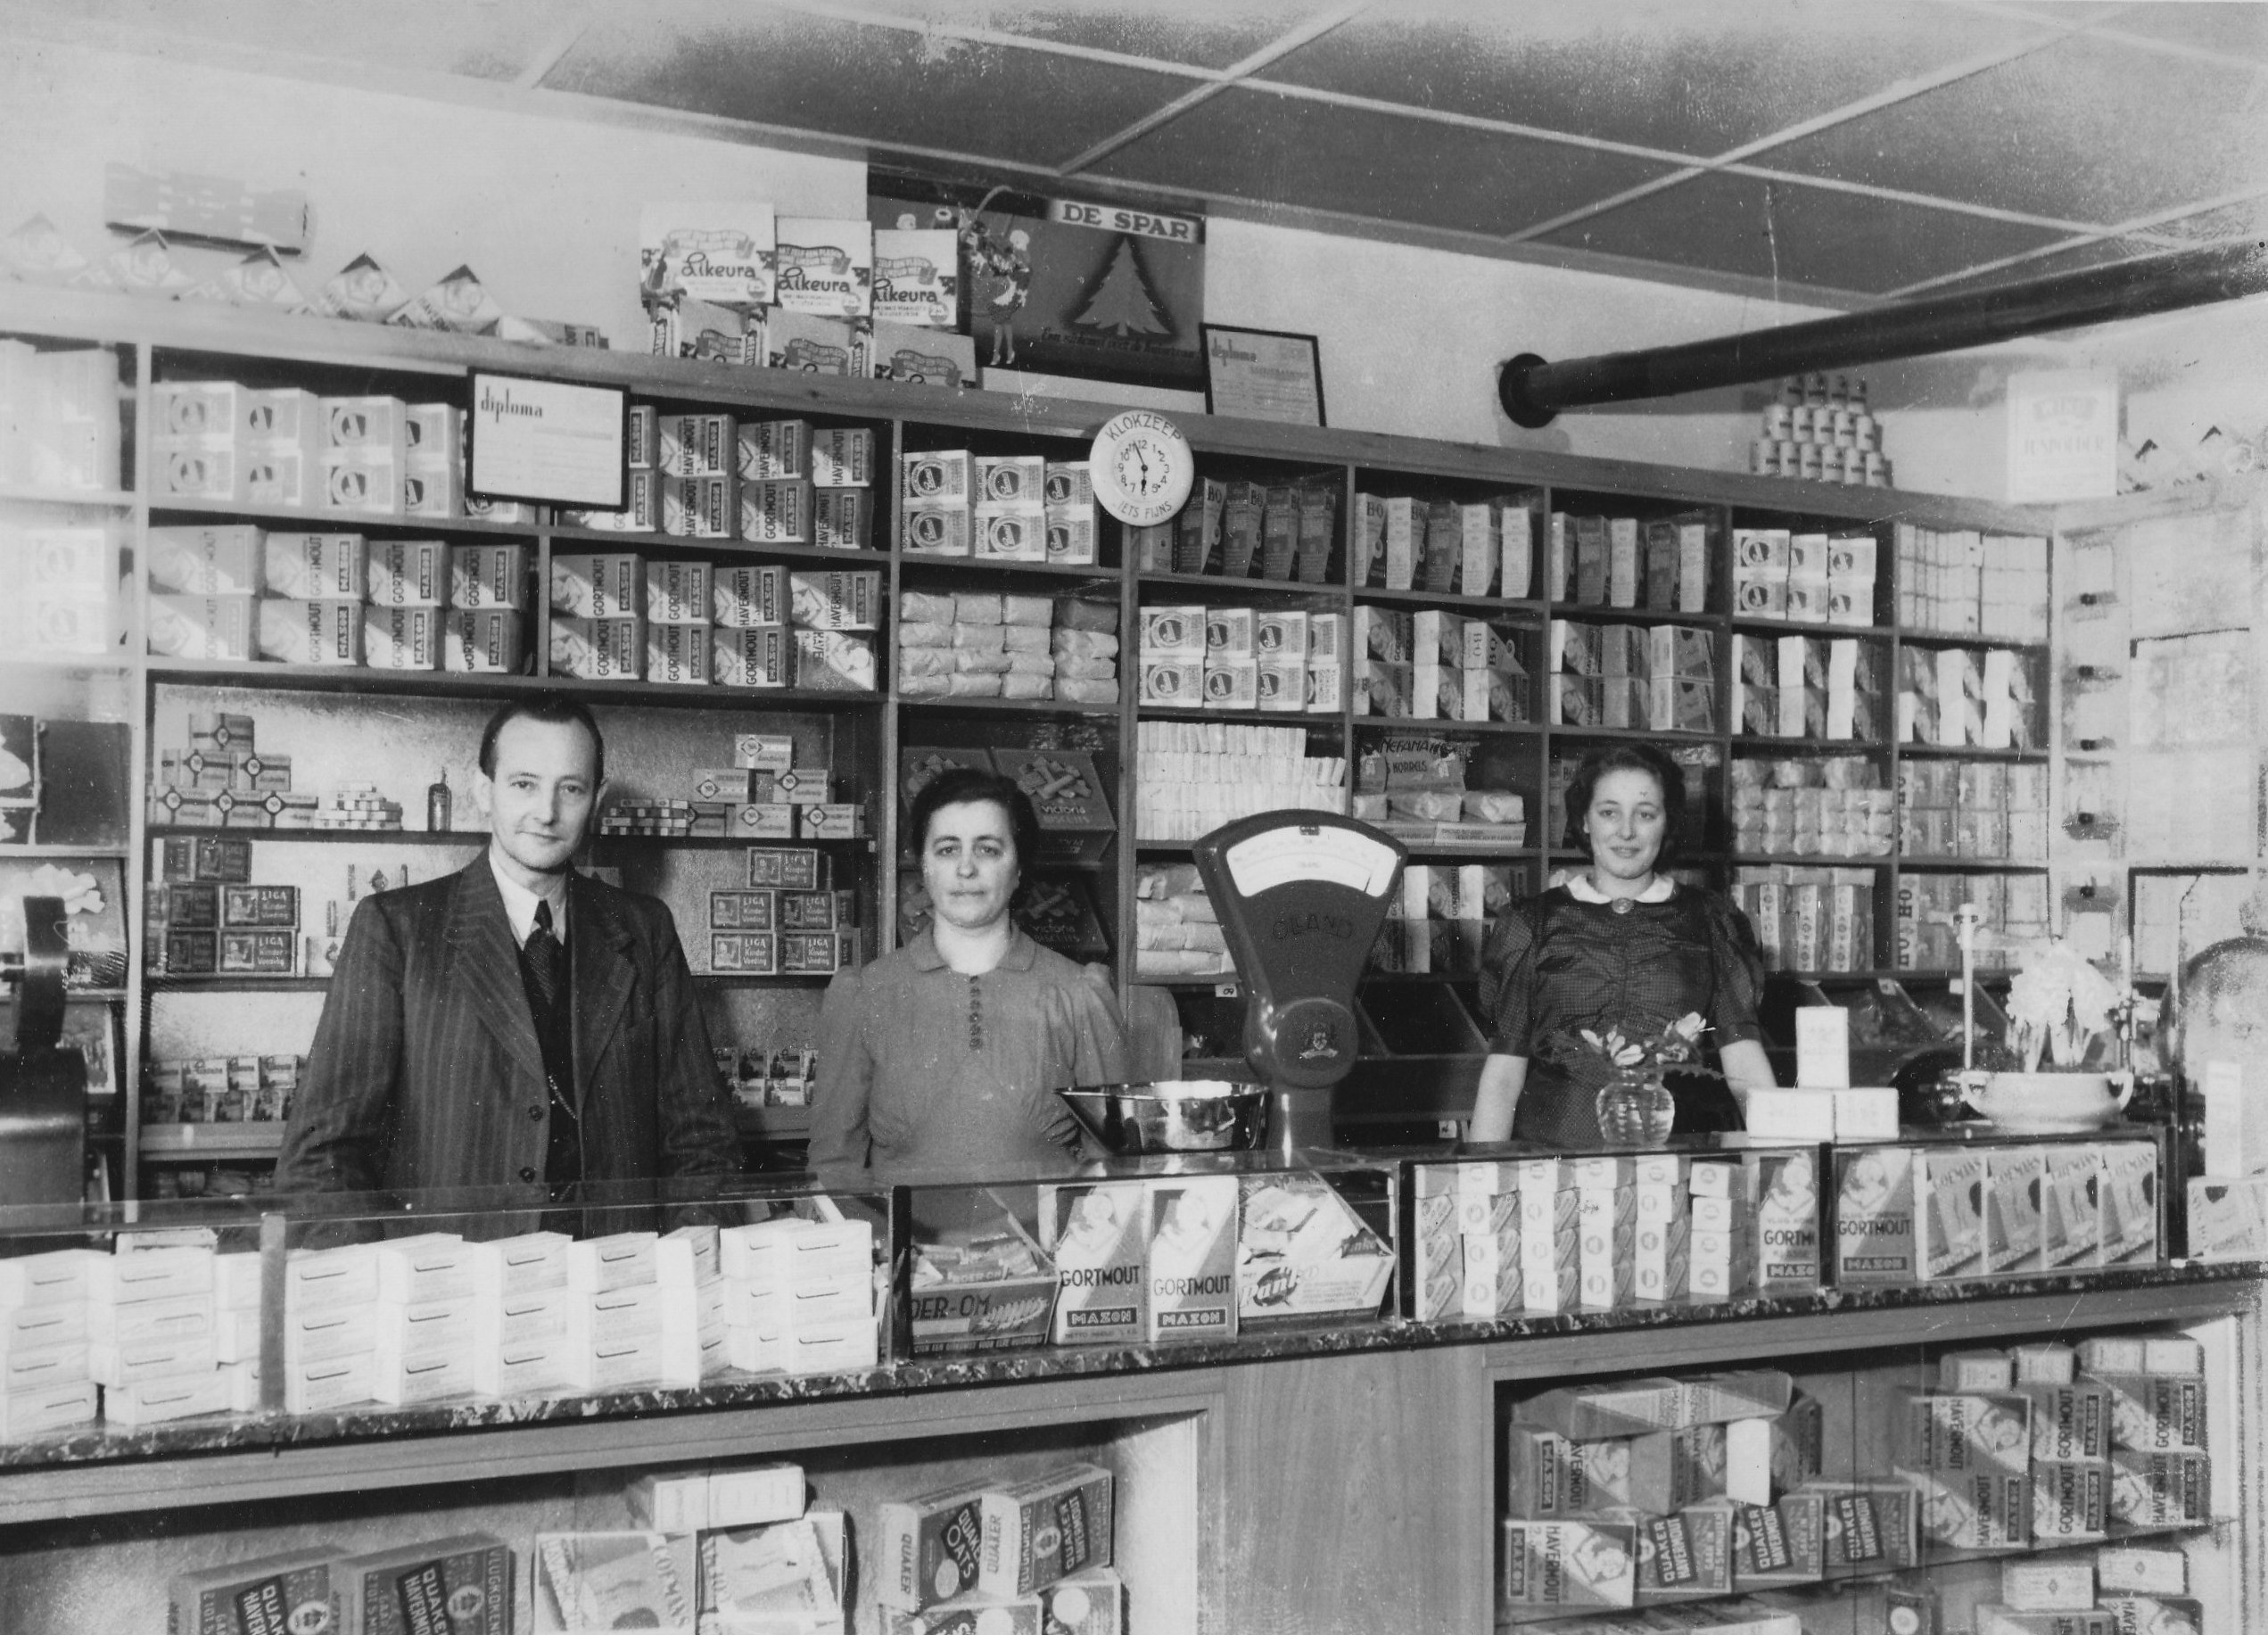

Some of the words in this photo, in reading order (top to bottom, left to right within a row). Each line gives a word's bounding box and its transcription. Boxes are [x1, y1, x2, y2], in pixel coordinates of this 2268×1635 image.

[1062, 203, 1101, 226] DE
[1114, 211, 1190, 239] SPAR
[481, 387, 542, 423] diploma
[1105, 414, 1182, 441] KLOKZEEP
[683, 417, 696, 475] HAVERMOUT
[760, 423, 771, 478] HAVERMOUT
[832, 431, 844, 484] HAVERMOUT
[1118, 463, 1124, 472] 9
[1120, 451, 1130, 461] 10
[1138, 440, 1147, 450] 12
[1152, 444, 1156, 453] 1
[1159, 453, 1165, 462] 2
[1164, 464, 1170, 474] 3
[1121, 475, 1126, 483] 8
[1130, 483, 1136, 492] 7
[1151, 483, 1159, 493] 5
[1160, 475, 1167, 483] 4
[686, 479, 697, 535] HAVERMOUT
[766, 483, 776, 539] GORTMOUT
[818, 494, 829, 546] HAVERMOUT
[1118, 501, 1140, 517] IETS
[1145, 500, 1172, 519] FIJNS
[204, 533, 217, 595] GORTMOUT
[309, 537, 322, 596] GORTMOUT
[392, 545, 404, 602] GORTMOUT
[470, 548, 481, 607] GORTMOUT
[592, 558, 605, 616] GORTMOUT
[668, 564, 680, 620] GORTMOUT
[738, 571, 749, 626] HAVERMOUT
[830, 573, 841, 627] HAVERMOUT
[309, 603, 321, 662] GORTMOUT
[392, 607, 405, 667] GORTMOUT
[598, 620, 609, 676] GORTMOUT
[668, 625, 680, 681] GORTMOUT
[746, 630, 756, 684] GORTMOUT
[260, 889, 287, 901] LIGA
[744, 897, 764, 906] LIGA
[806, 897, 825, 906] LIGA
[259, 937, 285, 946] LIGA
[745, 938, 766, 947] LIGA
[809, 938, 828, 947] LIGA
[1764, 1229, 1815, 1246] GORTM
[1838, 1219, 1910, 1236] GORTMOUT
[1061, 1266, 1139, 1286] GORTMOUT
[1154, 1276, 1231, 1296] GORTMOUT
[1769, 1265, 1816, 1277] MAZO
[1071, 1309, 1132, 1325] MAZON
[1162, 1311, 1220, 1326] MAZON
[2058, 1389, 2074, 1457] GORTMOUT
[2155, 1380, 2169, 1447] GORTMOUT
[1977, 1475, 1990, 1546] HAVERMOUT
[2059, 1465, 2074, 1533] GORTMOUT
[2152, 1452, 2166, 1523] HAVERMOUT
[947, 1524, 974, 1579] OATS
[959, 1509, 983, 1563] QUAKE
[986, 1515, 1001, 1574] QUAKER
[1062, 1504, 1076, 1571] QUAKER
[1654, 1521, 1675, 1582] QUAKER
[1668, 1518, 1691, 1580] HAVERMOUT
[1749, 1509, 1769, 1569] QUAKER
[1762, 1508, 1786, 1566] HAVERMOUT
[1841, 1499, 1861, 1559] QUAKER
[1857, 1498, 1876, 1557] HAVERMOUT
[901, 1533, 911, 1595] QUAKER
[1544, 1526, 1561, 1604] HAVERMOUT
[422, 1566, 448, 1635] QUAKE
